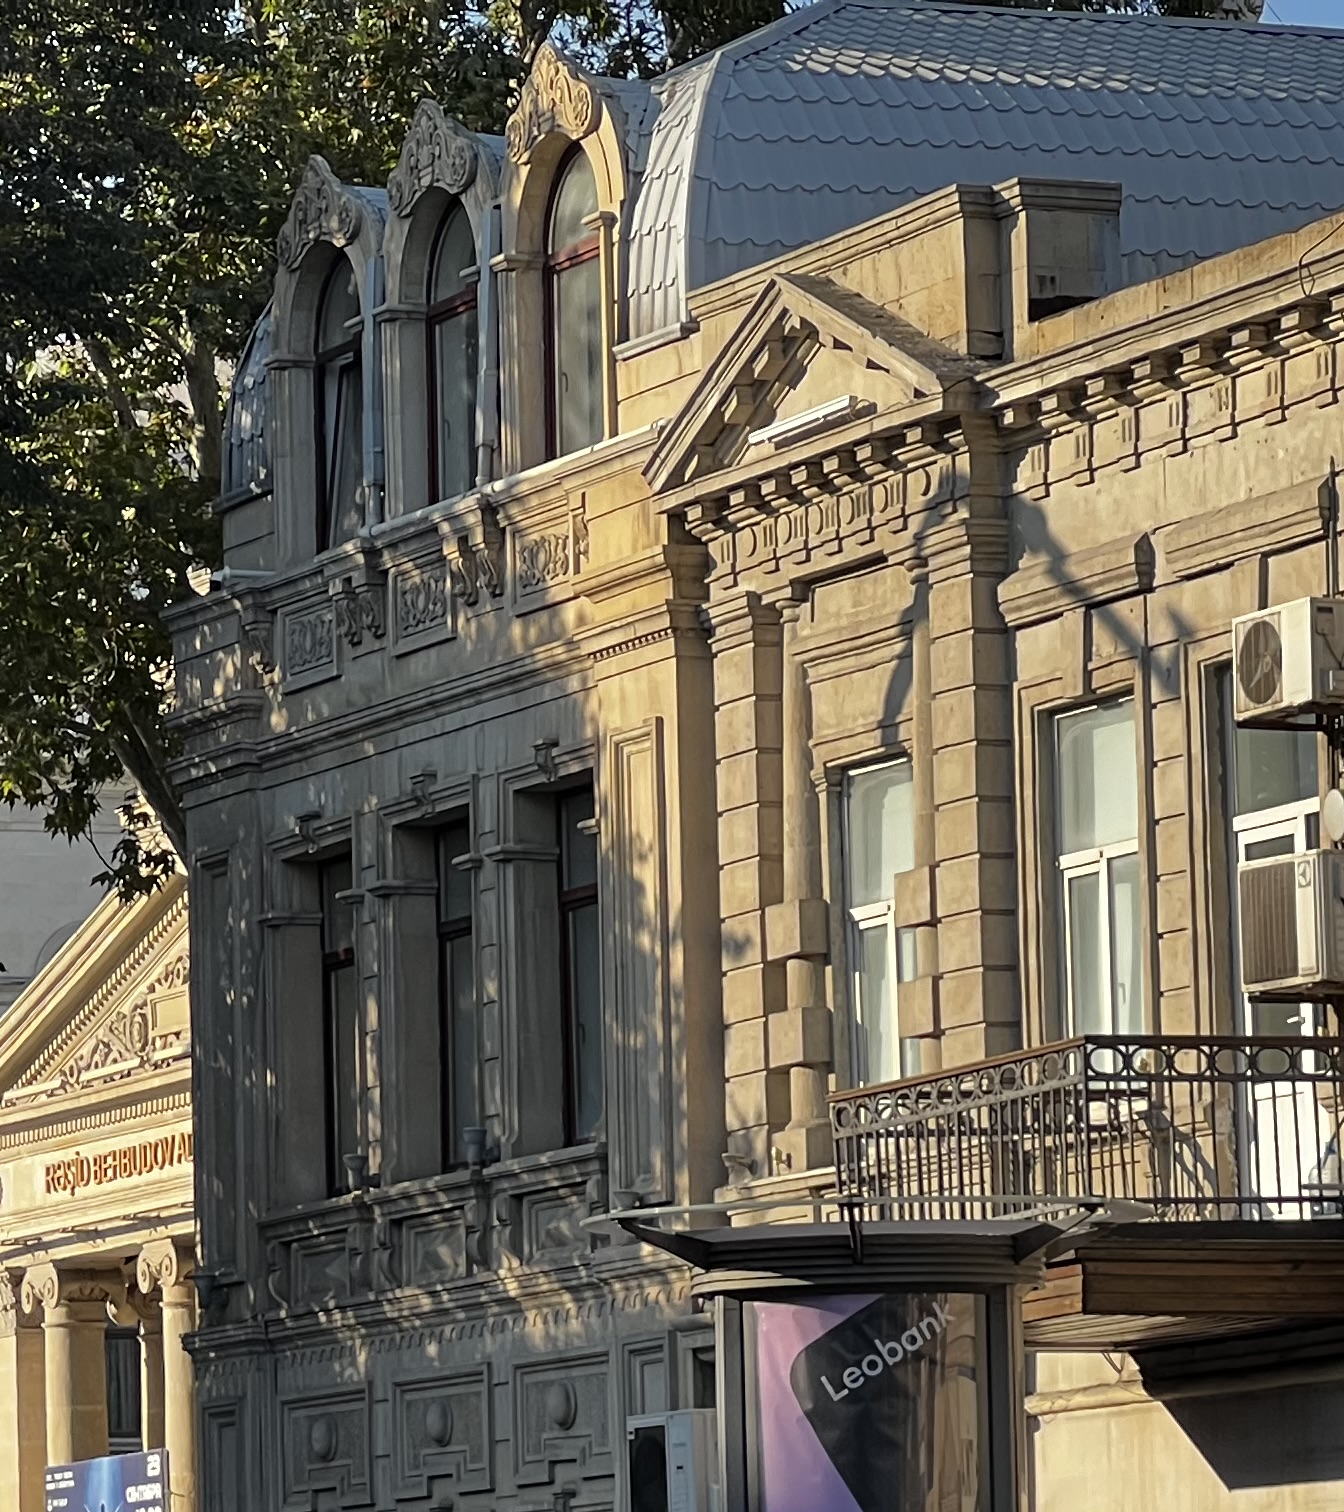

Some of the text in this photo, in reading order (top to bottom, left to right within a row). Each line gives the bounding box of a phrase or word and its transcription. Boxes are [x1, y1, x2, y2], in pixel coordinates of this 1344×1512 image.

[45, 1151, 91, 1197] RƏŞİD
[93, 1134, 175, 1186] BEHBUDOV
[820, 1301, 956, 1401] Leobank
